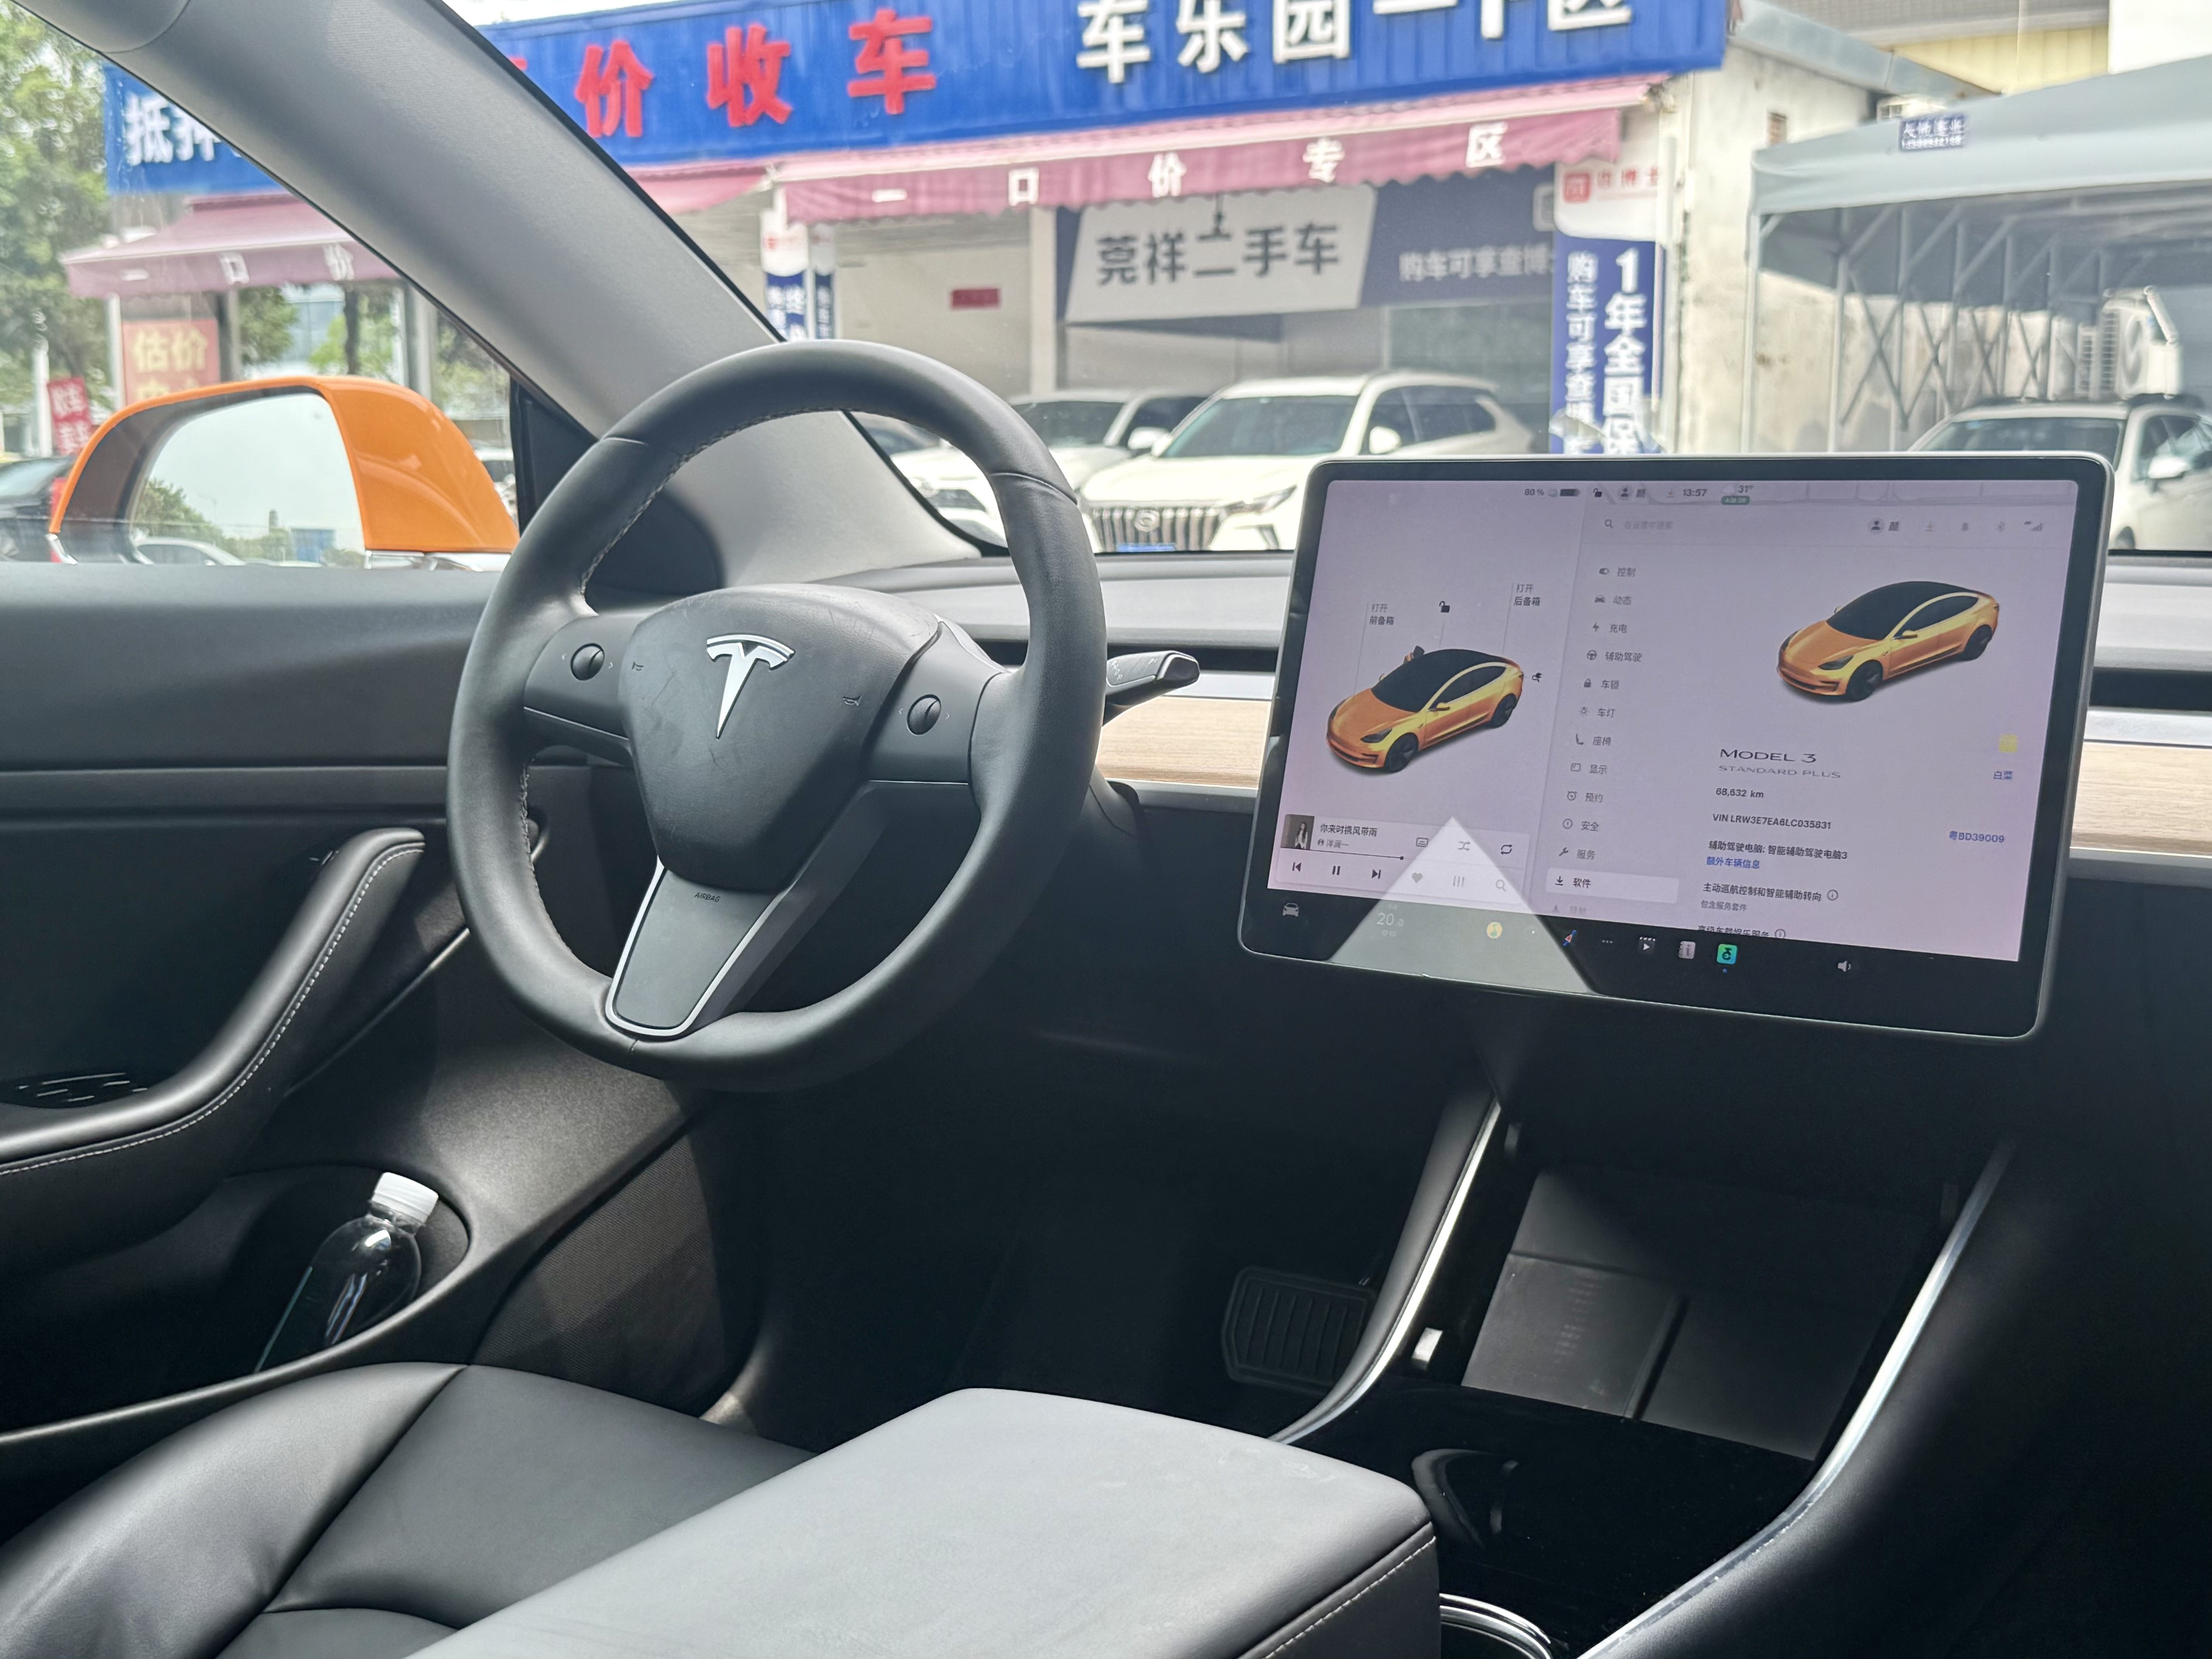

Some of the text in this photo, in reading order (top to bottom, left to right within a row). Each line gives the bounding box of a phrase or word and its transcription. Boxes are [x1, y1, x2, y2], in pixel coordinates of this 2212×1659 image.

[1076, 0, 1632, 83] 车乐园一
[508, 8, 937, 138] 价收车
[871, 121, 1508, 206] 一口价专区
[1097, 222, 1340, 286] 莞祥二手车
[1399, 244, 1554, 282] 购车可享查博
[1738, 485, 1753, 493] 31°
[1617, 567, 1636, 577] 控制
[1516, 584, 1534, 593] 打开
[1513, 596, 1540, 606] 后备箱
[1613, 596, 1632, 605] 动态
[1371, 604, 1388, 613] 打开
[1369, 616, 1394, 625] 前备箱
[1609, 623, 1627, 634] 充电
[1605, 651, 1642, 662] 辅助驾驶
[1601, 679, 1620, 690] 车锁
[1597, 708, 1616, 718] 车灯
[1592, 736, 1611, 746] 座椅
[1720, 748, 1817, 763] MODEL 3
[1589, 764, 1607, 775] 显示
[1719, 764, 1841, 778] STANDARD PLUS
[1585, 792, 1604, 803] 预约
[1716, 788, 1764, 798] 68,632 km
[1712, 813, 1729, 822] VIN
[1581, 821, 1599, 831] 安全
[1577, 849, 1595, 860] 服务
[1706, 856, 1760, 869] 额外车辆信息
[1573, 877, 1591, 888] 软件
[694, 892, 721, 902] AIRBAG
[1702, 882, 1822, 902] 主动巡航控制和智能辅助转向
[1700, 900, 1747, 912] 包含服务套件
